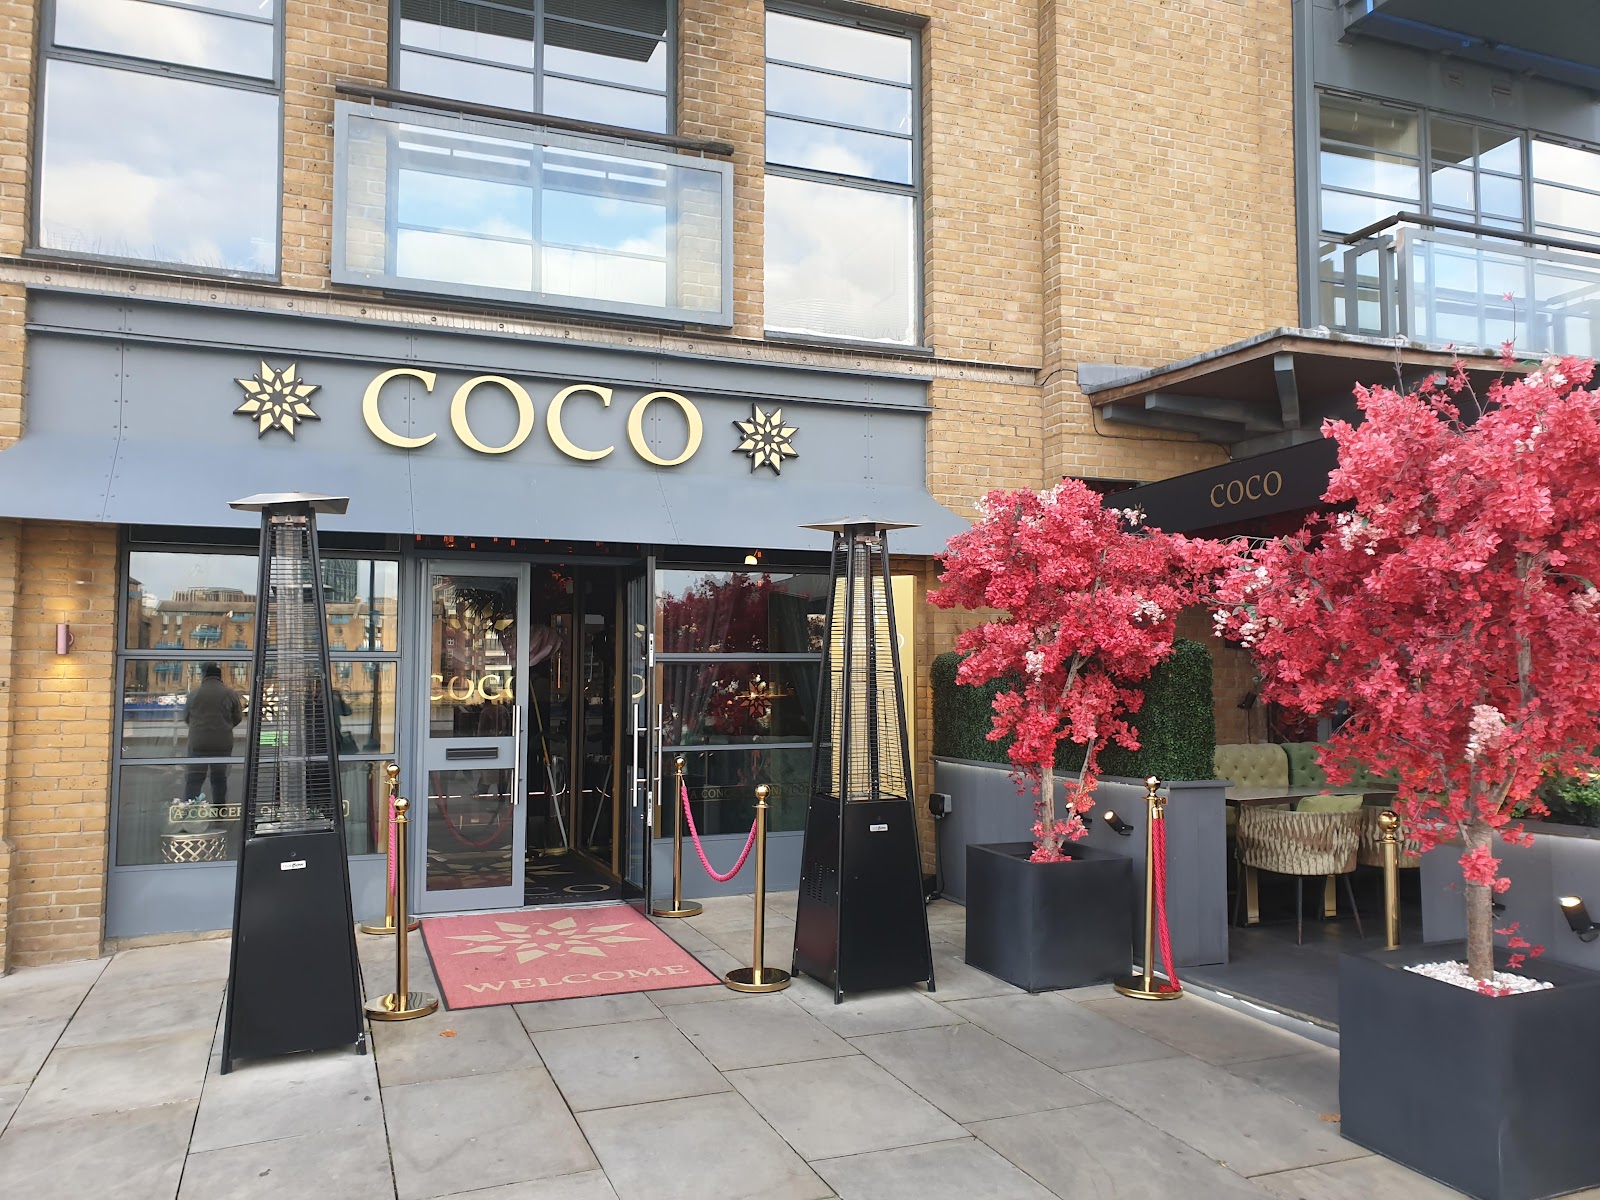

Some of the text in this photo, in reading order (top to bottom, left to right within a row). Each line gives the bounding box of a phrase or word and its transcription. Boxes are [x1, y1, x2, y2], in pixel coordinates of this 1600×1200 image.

[362, 367, 703, 467] COCO
[1210, 470, 1283, 509] COCO
[463, 966, 690, 993] WELCOME
